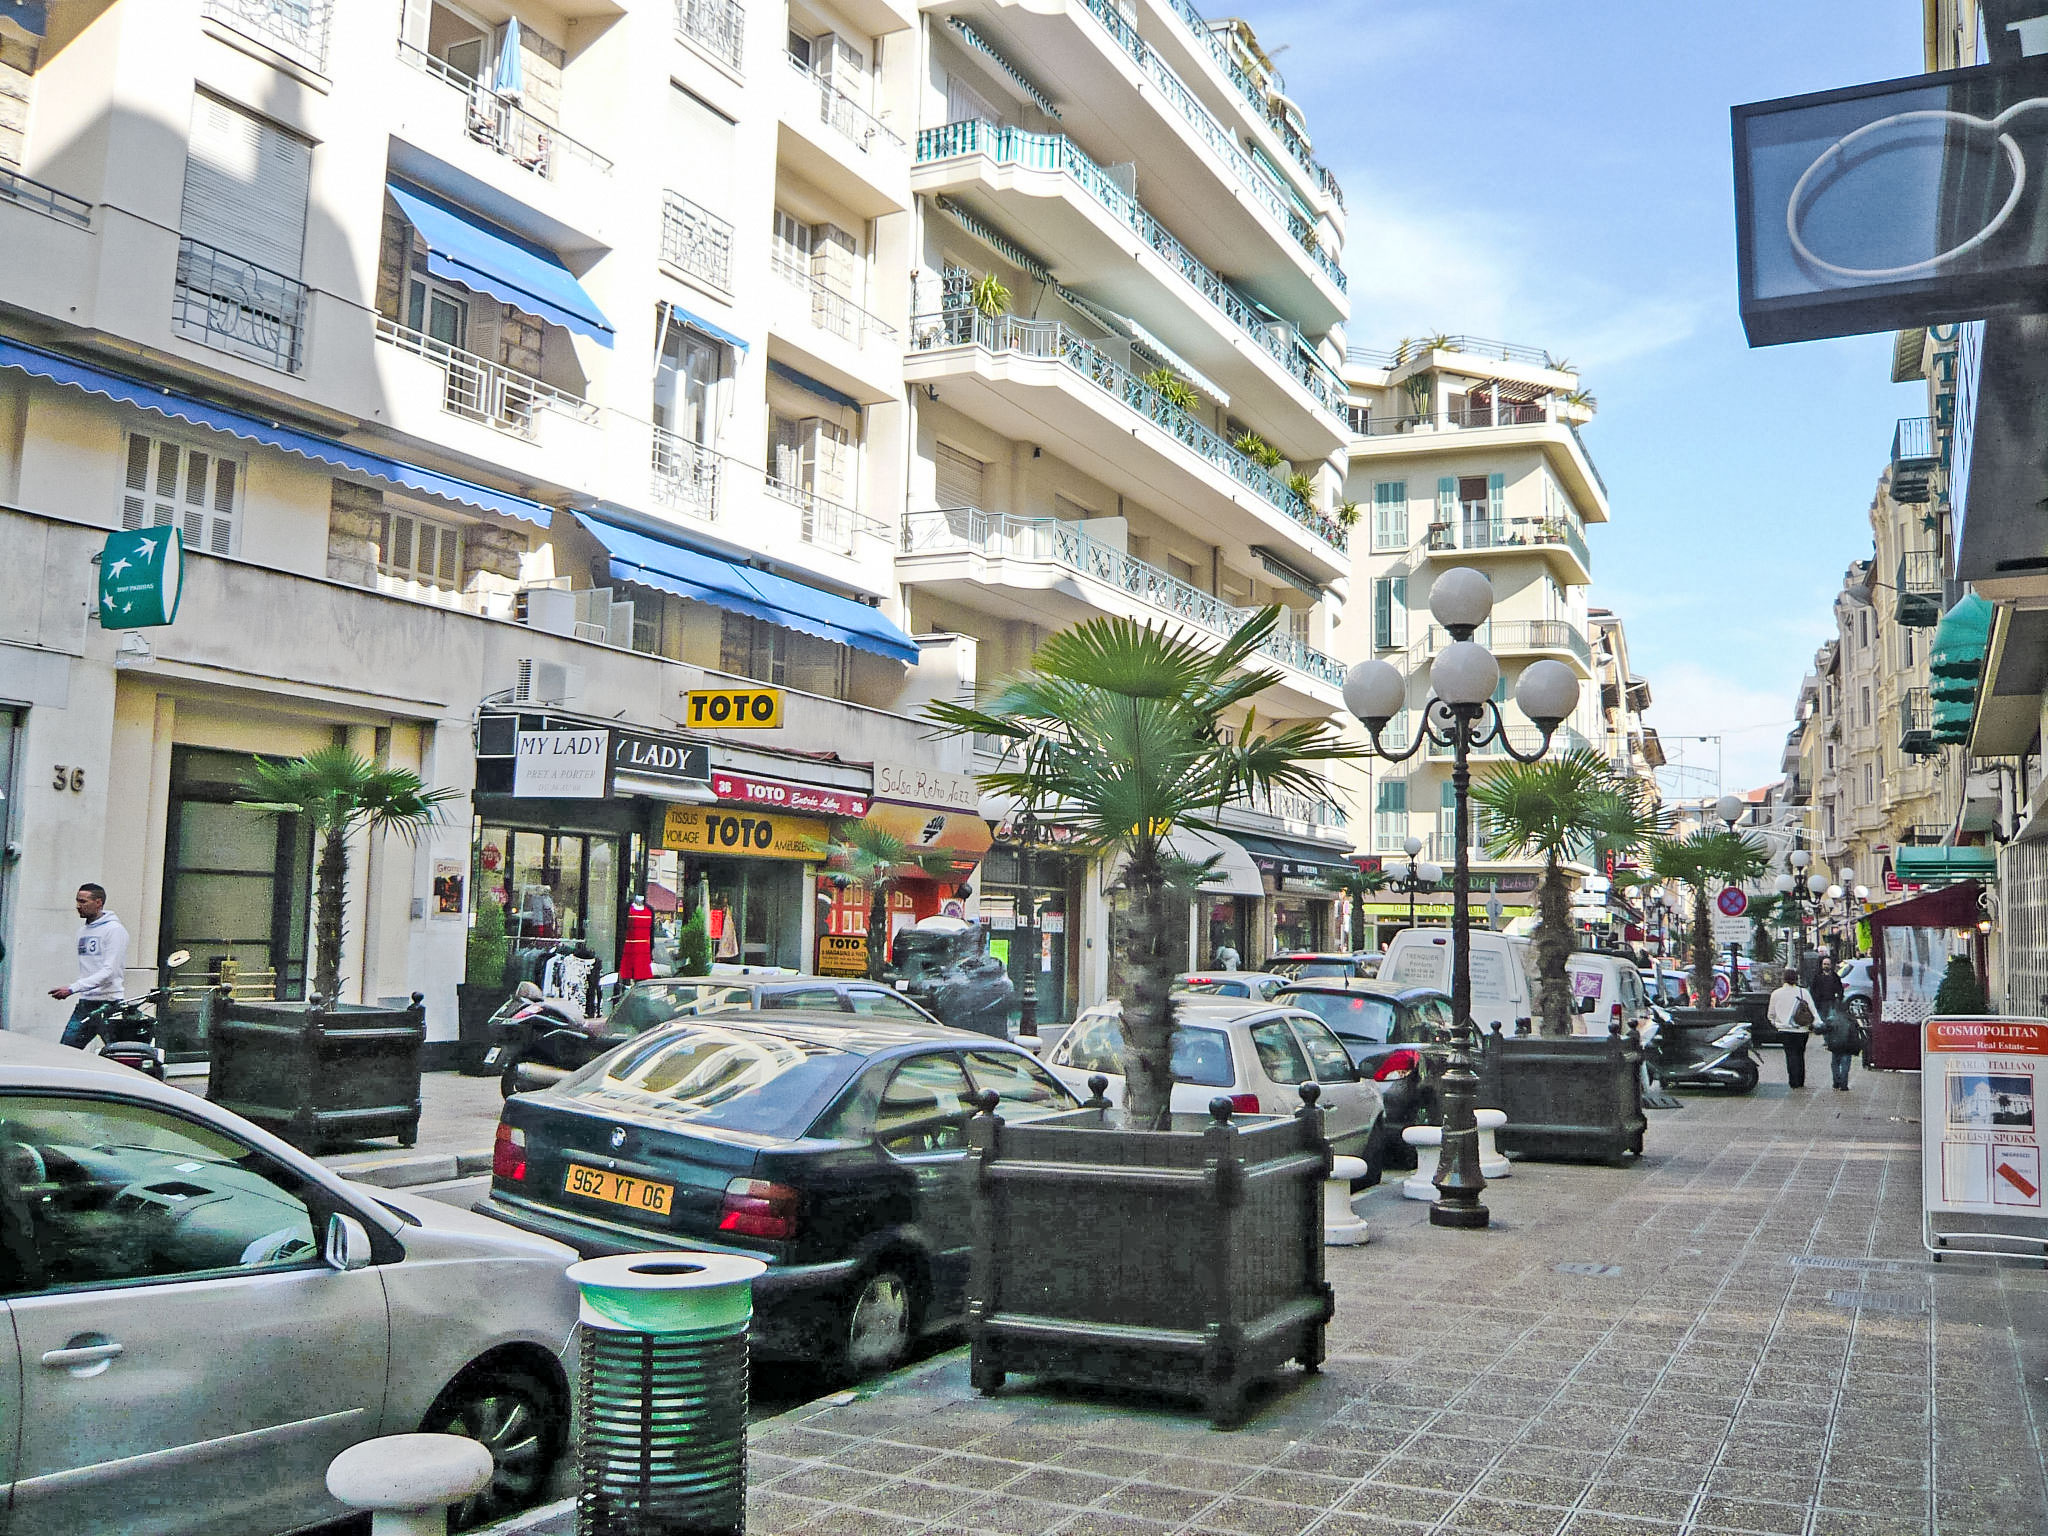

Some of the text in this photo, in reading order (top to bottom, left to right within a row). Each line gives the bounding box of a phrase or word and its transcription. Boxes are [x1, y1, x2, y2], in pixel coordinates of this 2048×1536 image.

[692, 694, 774, 722] TOTO
[519, 736, 607, 756] MY LADY
[630, 741, 693, 771] LADY
[53, 765, 85, 792] 36
[526, 769, 549, 778] PRET
[560, 769, 597, 779] PORTER
[880, 767, 911, 794] Salsa
[914, 771, 945, 798] Retro
[946, 780, 970, 804] Jazz
[718, 780, 732, 793] 36
[746, 783, 786, 801] TOTO
[851, 801, 863, 813] 36
[666, 829, 699, 844] VOILAGE
[671, 811, 773, 849] TISSUS TOTO
[89, 940, 97, 952] 3
[829, 938, 860, 949] TOTO
[1937, 1025, 2038, 1037] COSMOPOLITAN
[1976, 1041, 2025, 1050] Real Estate
[1988, 1060, 2036, 1071] ITALIANO
[1945, 1130, 2037, 1144] ENGLISH SPOKEN
[573, 1169, 665, 1209] 962 YT 06
